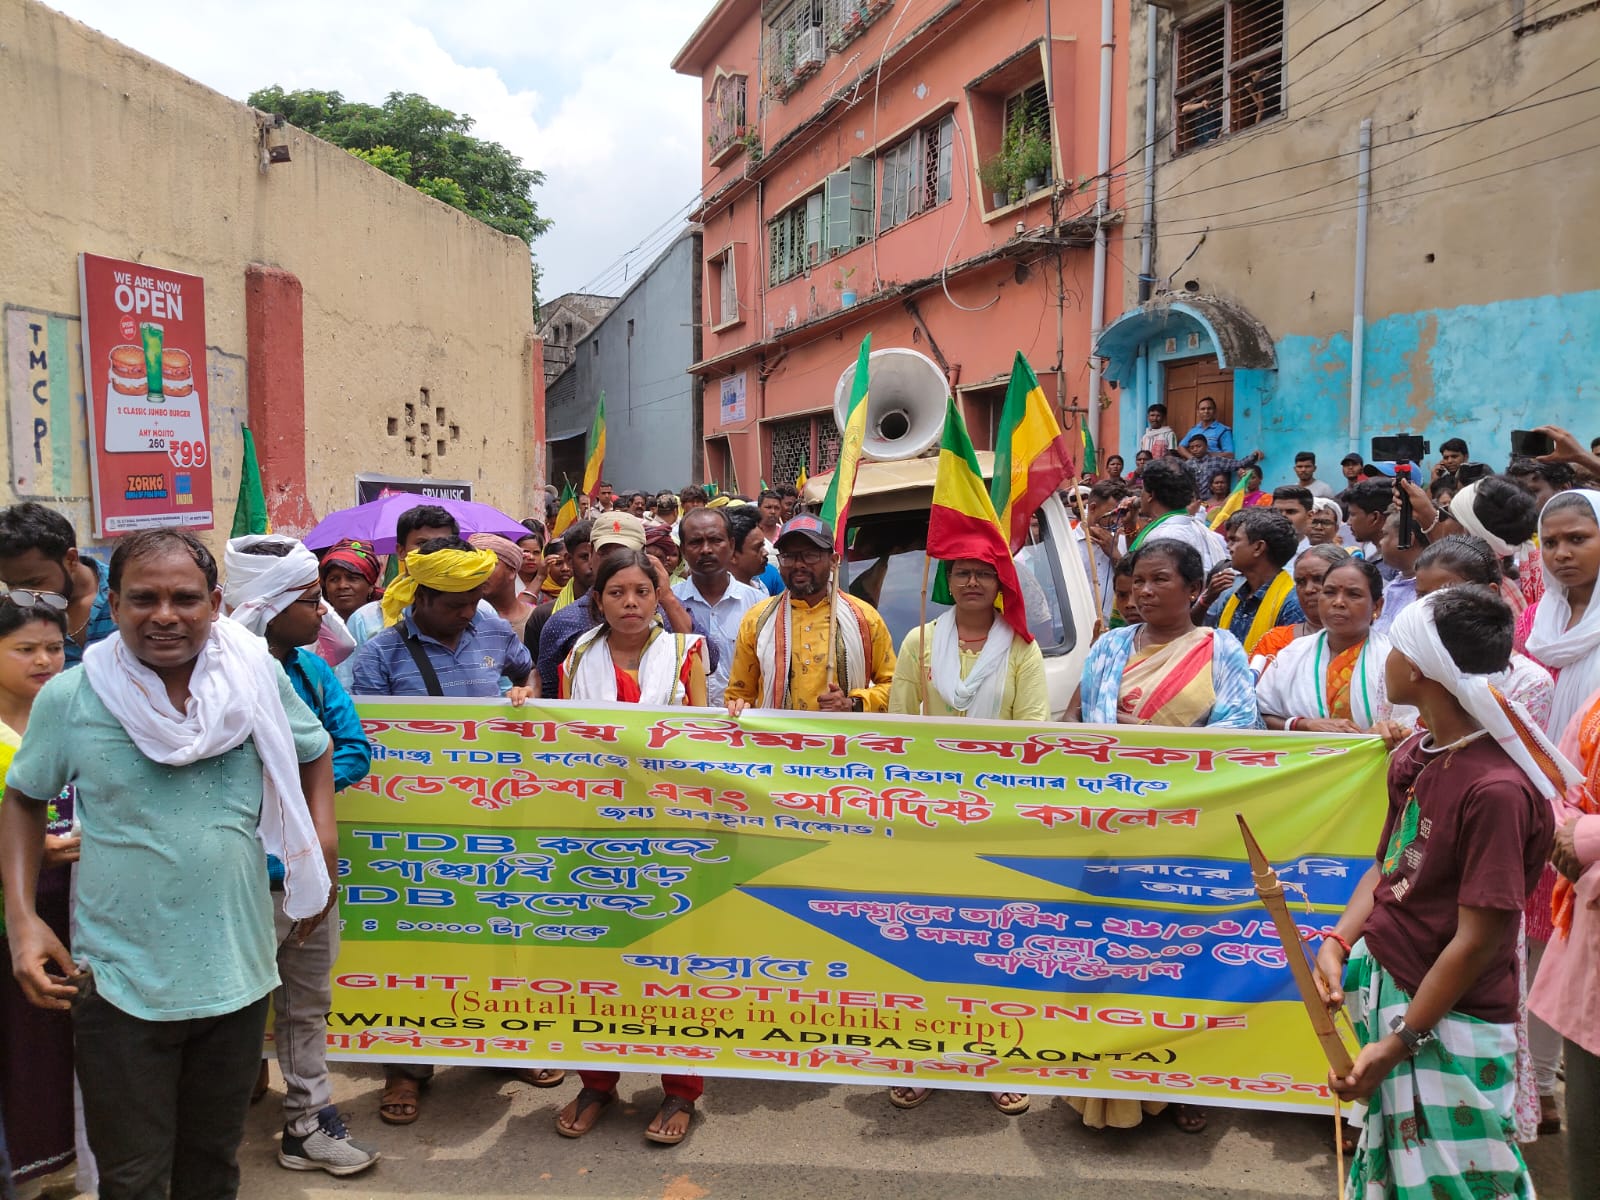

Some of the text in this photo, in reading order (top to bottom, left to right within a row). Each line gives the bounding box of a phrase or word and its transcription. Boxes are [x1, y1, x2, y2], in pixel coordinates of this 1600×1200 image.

[114, 271, 181, 295] WE ARE NOW
[115, 284, 183, 321] OPEN
[123, 406, 147, 416] CLASSIC
[148, 408, 168, 417] JUMBO
[169, 409, 191, 418] BURGER
[139, 428, 174, 438] ANY MOJITO
[168, 439, 207, 468] ₹99
[127, 475, 164, 492] ZORKO
[648, 718, 913, 756] শিক্ষার
[936, 732, 1288, 771] অধিকার
[442, 750, 522, 765] TDB
[533, 752, 630, 769] কলেজে
[884, 765, 964, 785] বিভাগ
[974, 770, 1066, 792] খোলার
[1076, 771, 1171, 797] দাবীতে
[597, 805, 656, 822] জন্য
[665, 806, 765, 829] অবস্থান
[774, 814, 875, 837] বিক্ষোভ
[647, 782, 749, 813] এবং
[1015, 804, 1201, 834] কালের
[353, 830, 729, 864] TDB কলেজ
[1083, 863, 1233, 881] সবারে
[337, 884, 457, 908] DB
[487, 917, 533, 938] টা
[534, 924, 609, 941] থেকে
[808, 899, 953, 926] অবস্থানের
[960, 902, 1069, 931] তারিখ
[880, 920, 908, 940] ও
[916, 927, 992, 947] সময়
[1023, 935, 1109, 959] বেলা
[622, 953, 812, 982] আহ্বানে
[336, 973, 1247, 1031] GHT FOR MOTHER TONGUE
[451, 989, 1024, 1048] (Santali language in olchiki script)
[500, 1018, 557, 1032] OF
[572, 1019, 745, 1040] DISHOM
[761, 1027, 945, 1054] ADIBASI
[963, 1040, 1177, 1064] GAONTA)
[582, 1040, 722, 1061] সমস্ত
[733, 1046, 1001, 1079] আদিবাসী
